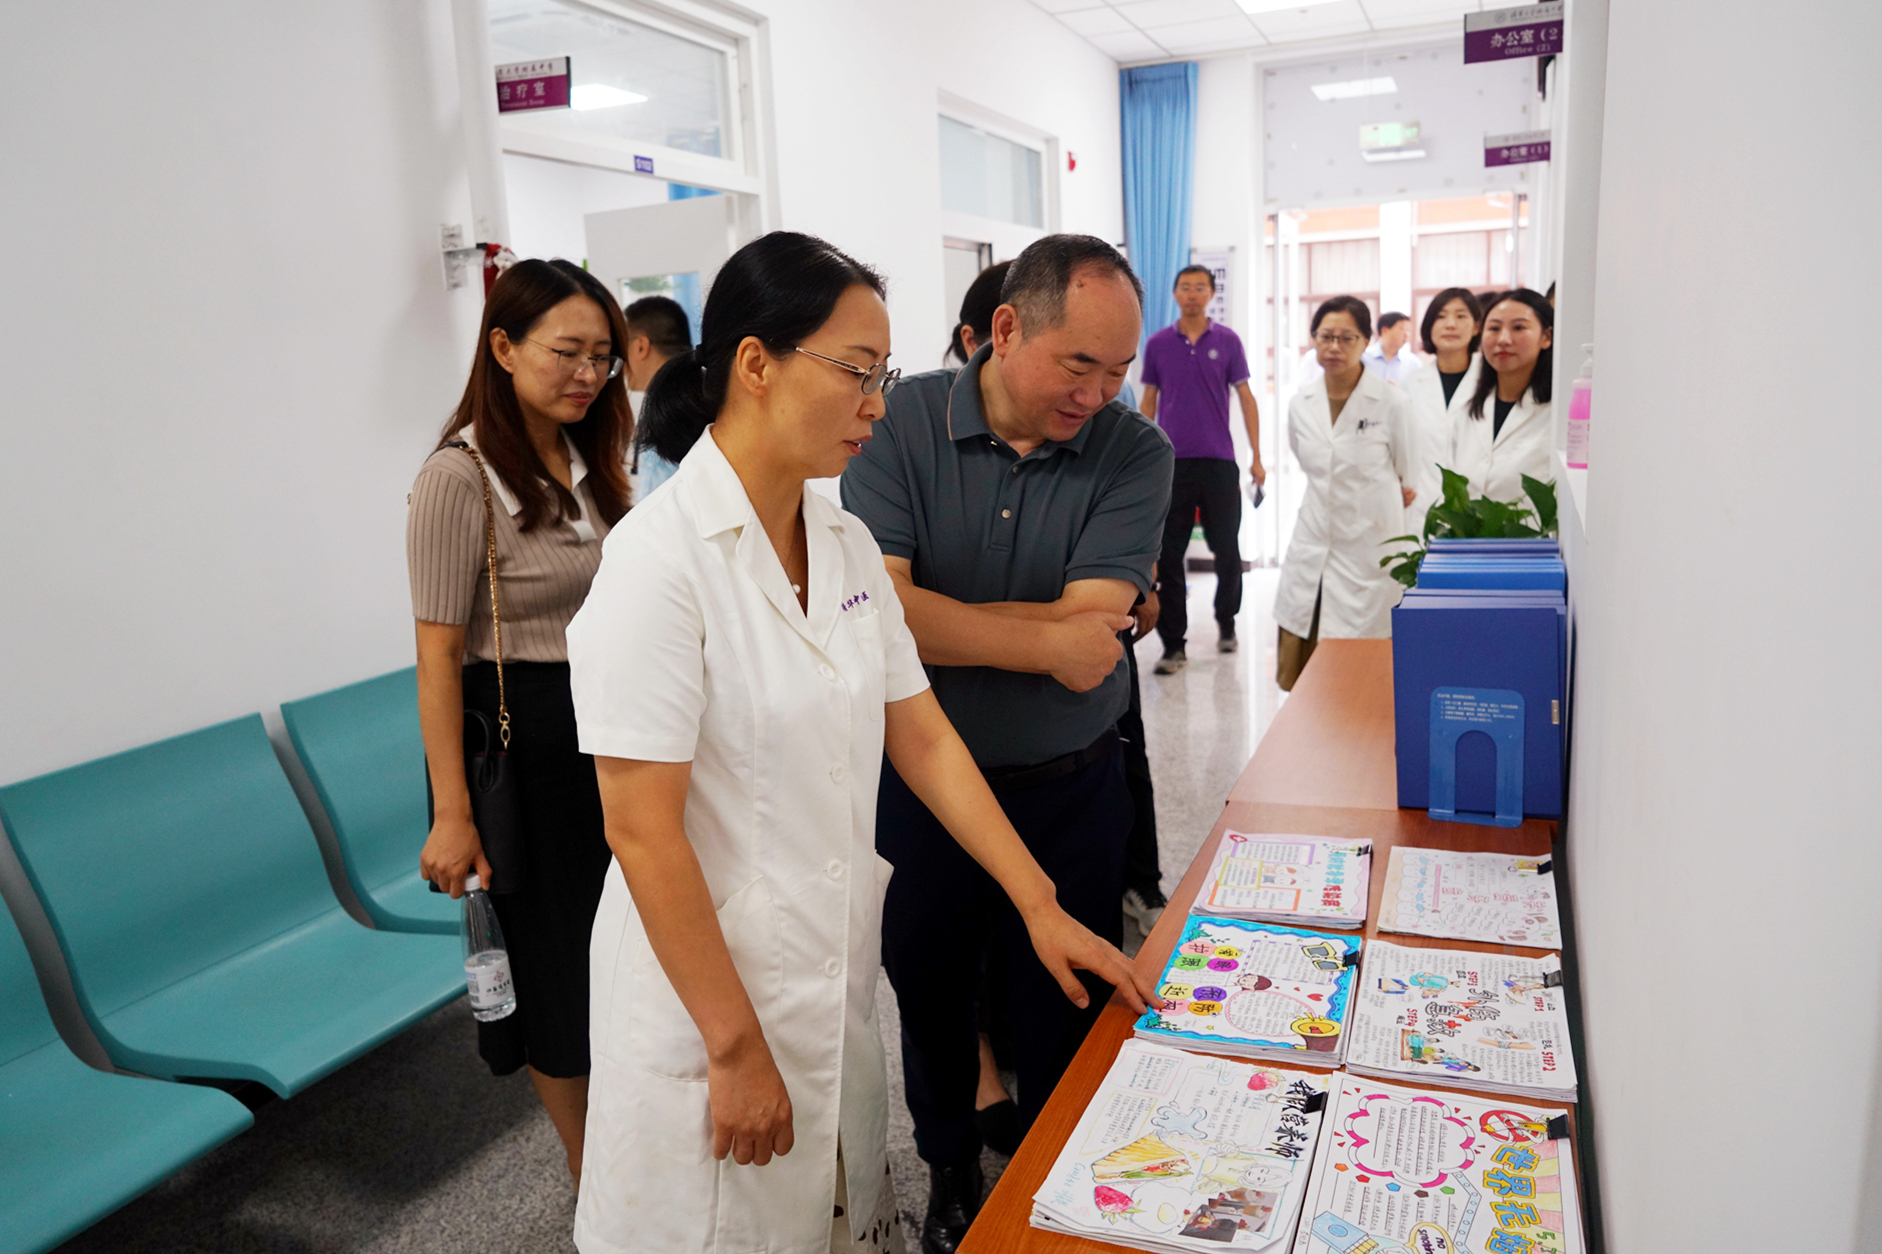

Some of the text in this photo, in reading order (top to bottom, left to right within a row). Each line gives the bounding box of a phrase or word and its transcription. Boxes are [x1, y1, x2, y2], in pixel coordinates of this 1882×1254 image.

[1490, 27, 1564, 49] 办公室（2
[1504, 45, 1534, 55] Office
[499, 80, 546, 101] 治疗室
[1435, 1236, 1446, 1250] no
